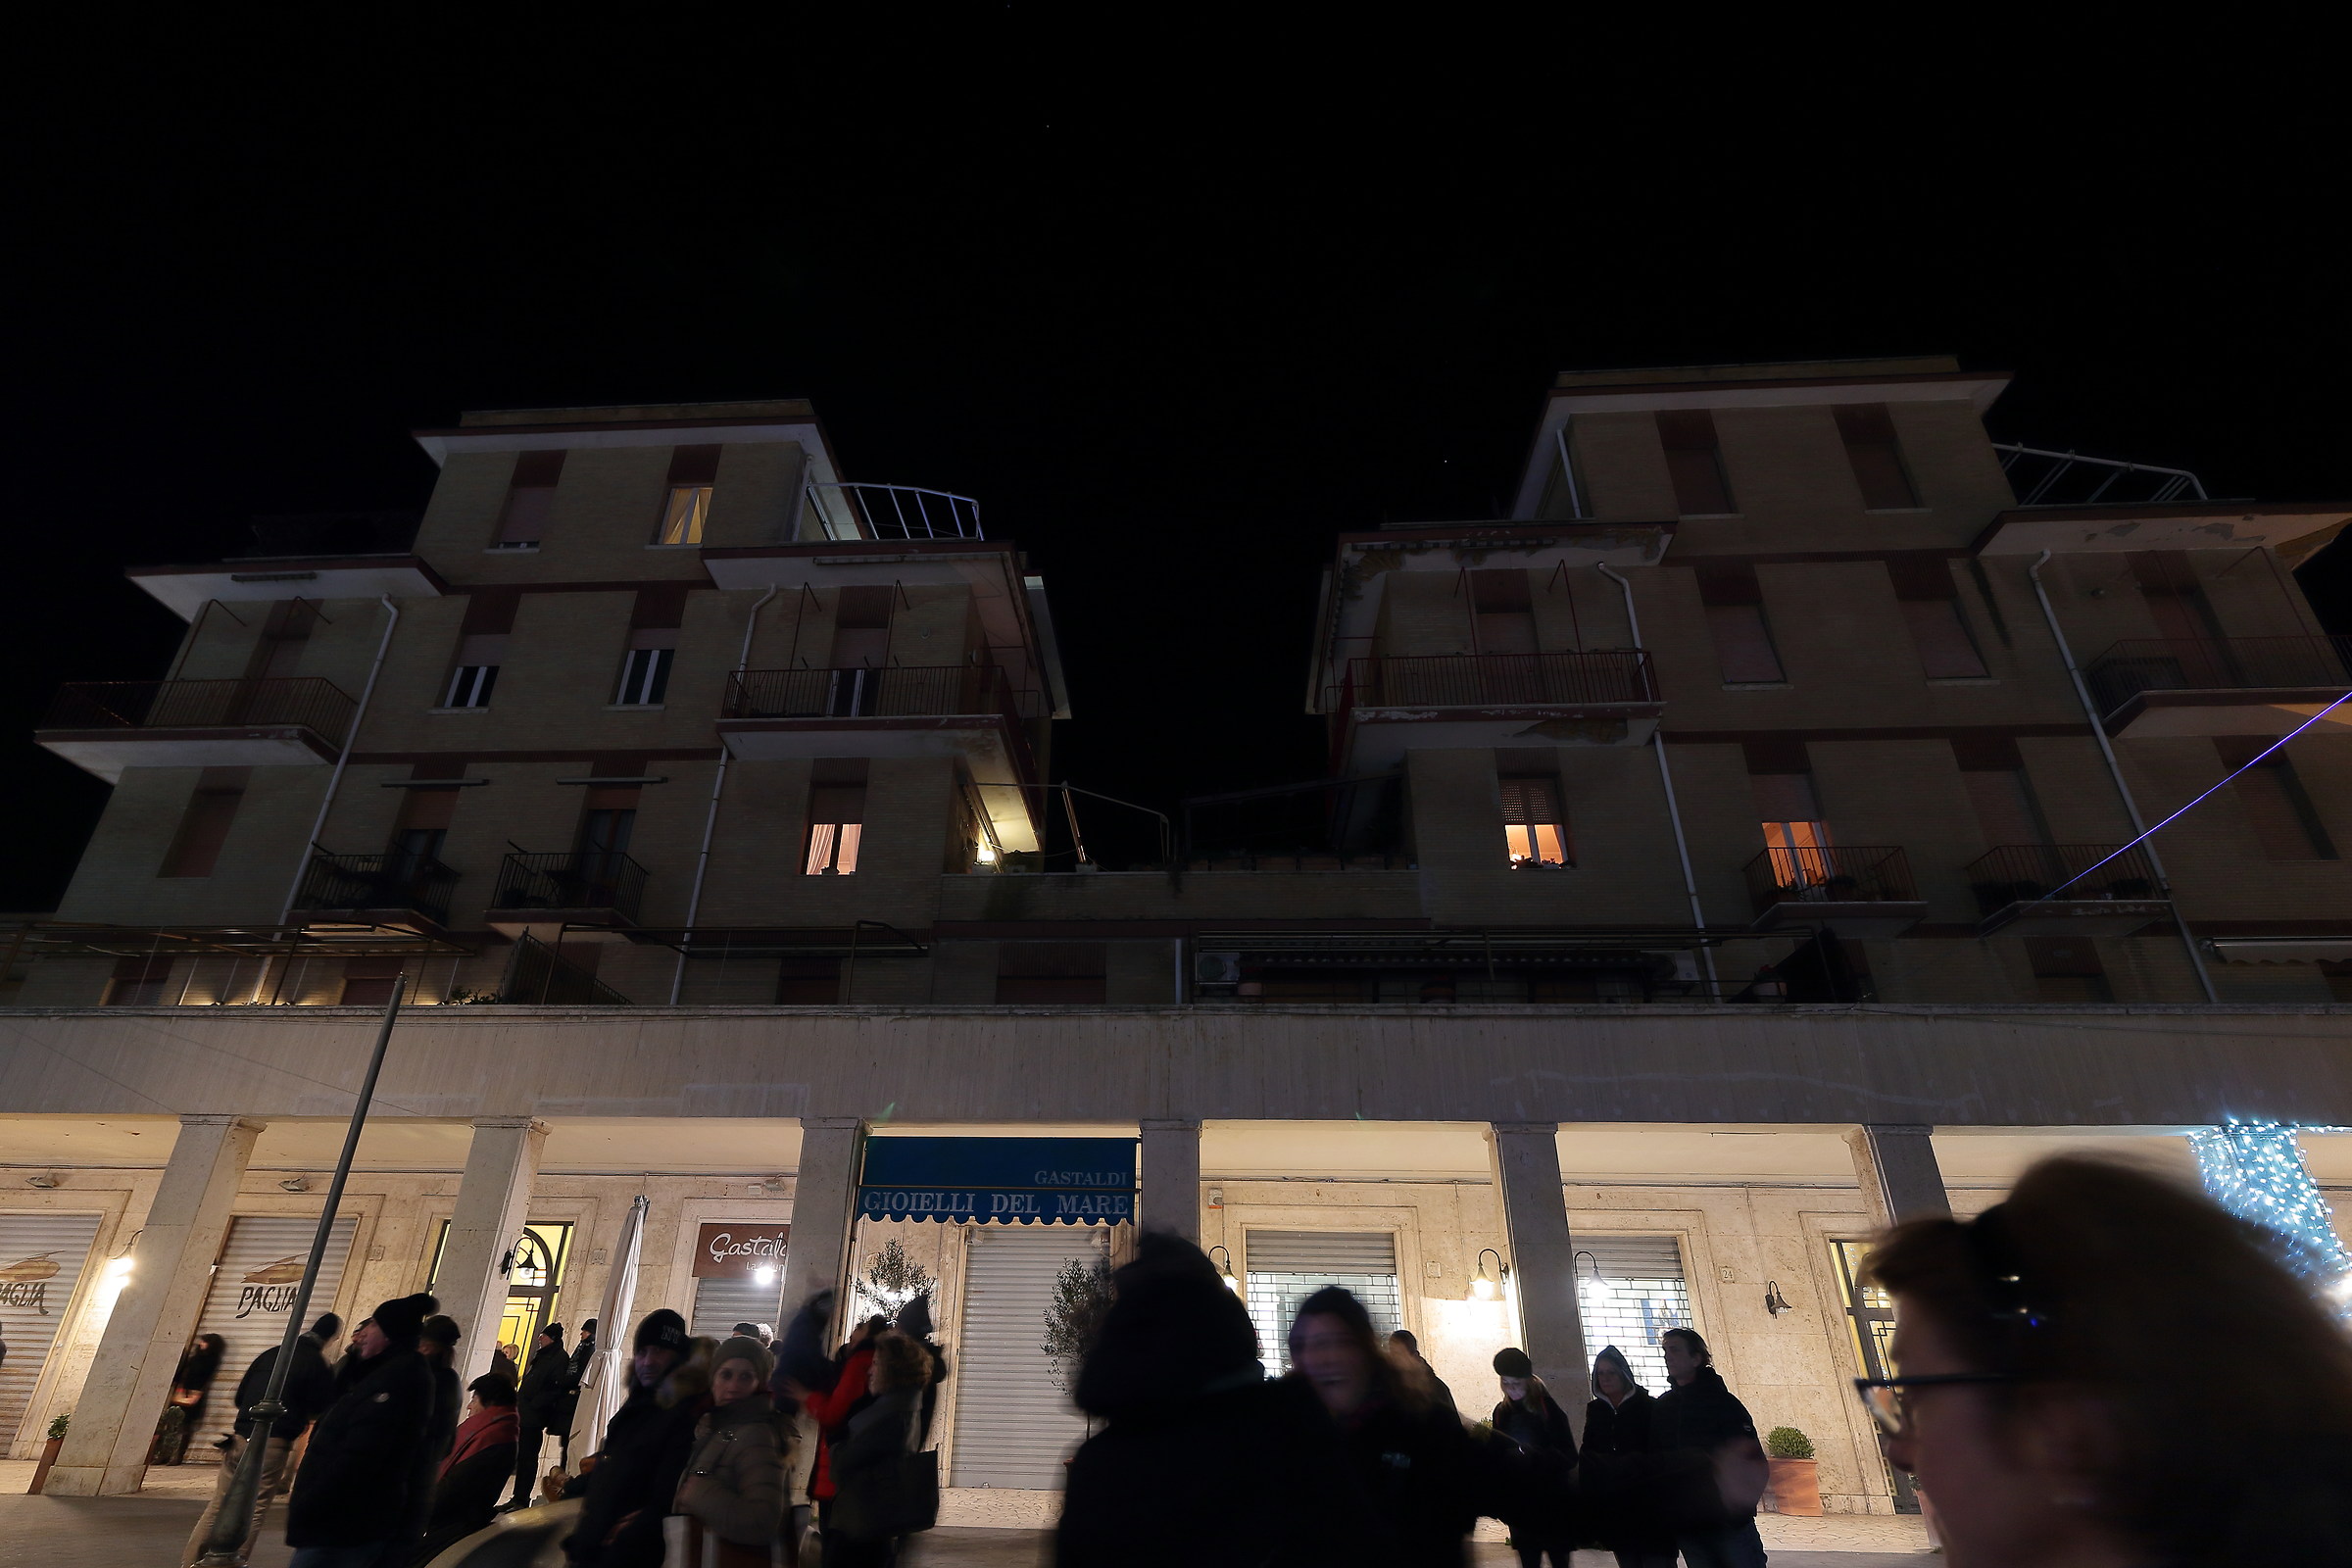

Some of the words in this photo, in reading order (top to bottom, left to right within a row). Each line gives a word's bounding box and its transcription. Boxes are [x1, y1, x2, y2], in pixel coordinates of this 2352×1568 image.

[1034, 1170, 1127, 1186] GASTALDI
[863, 1192, 976, 1212] GIOIELLI
[990, 1194, 1041, 1214] DEL
[1055, 1195, 1128, 1215] MARE
[1722, 1269, 1733, 1279] 24
[0, 1282, 49, 1315] AGLIA
[235, 1286, 298, 1319] PAGLIA
